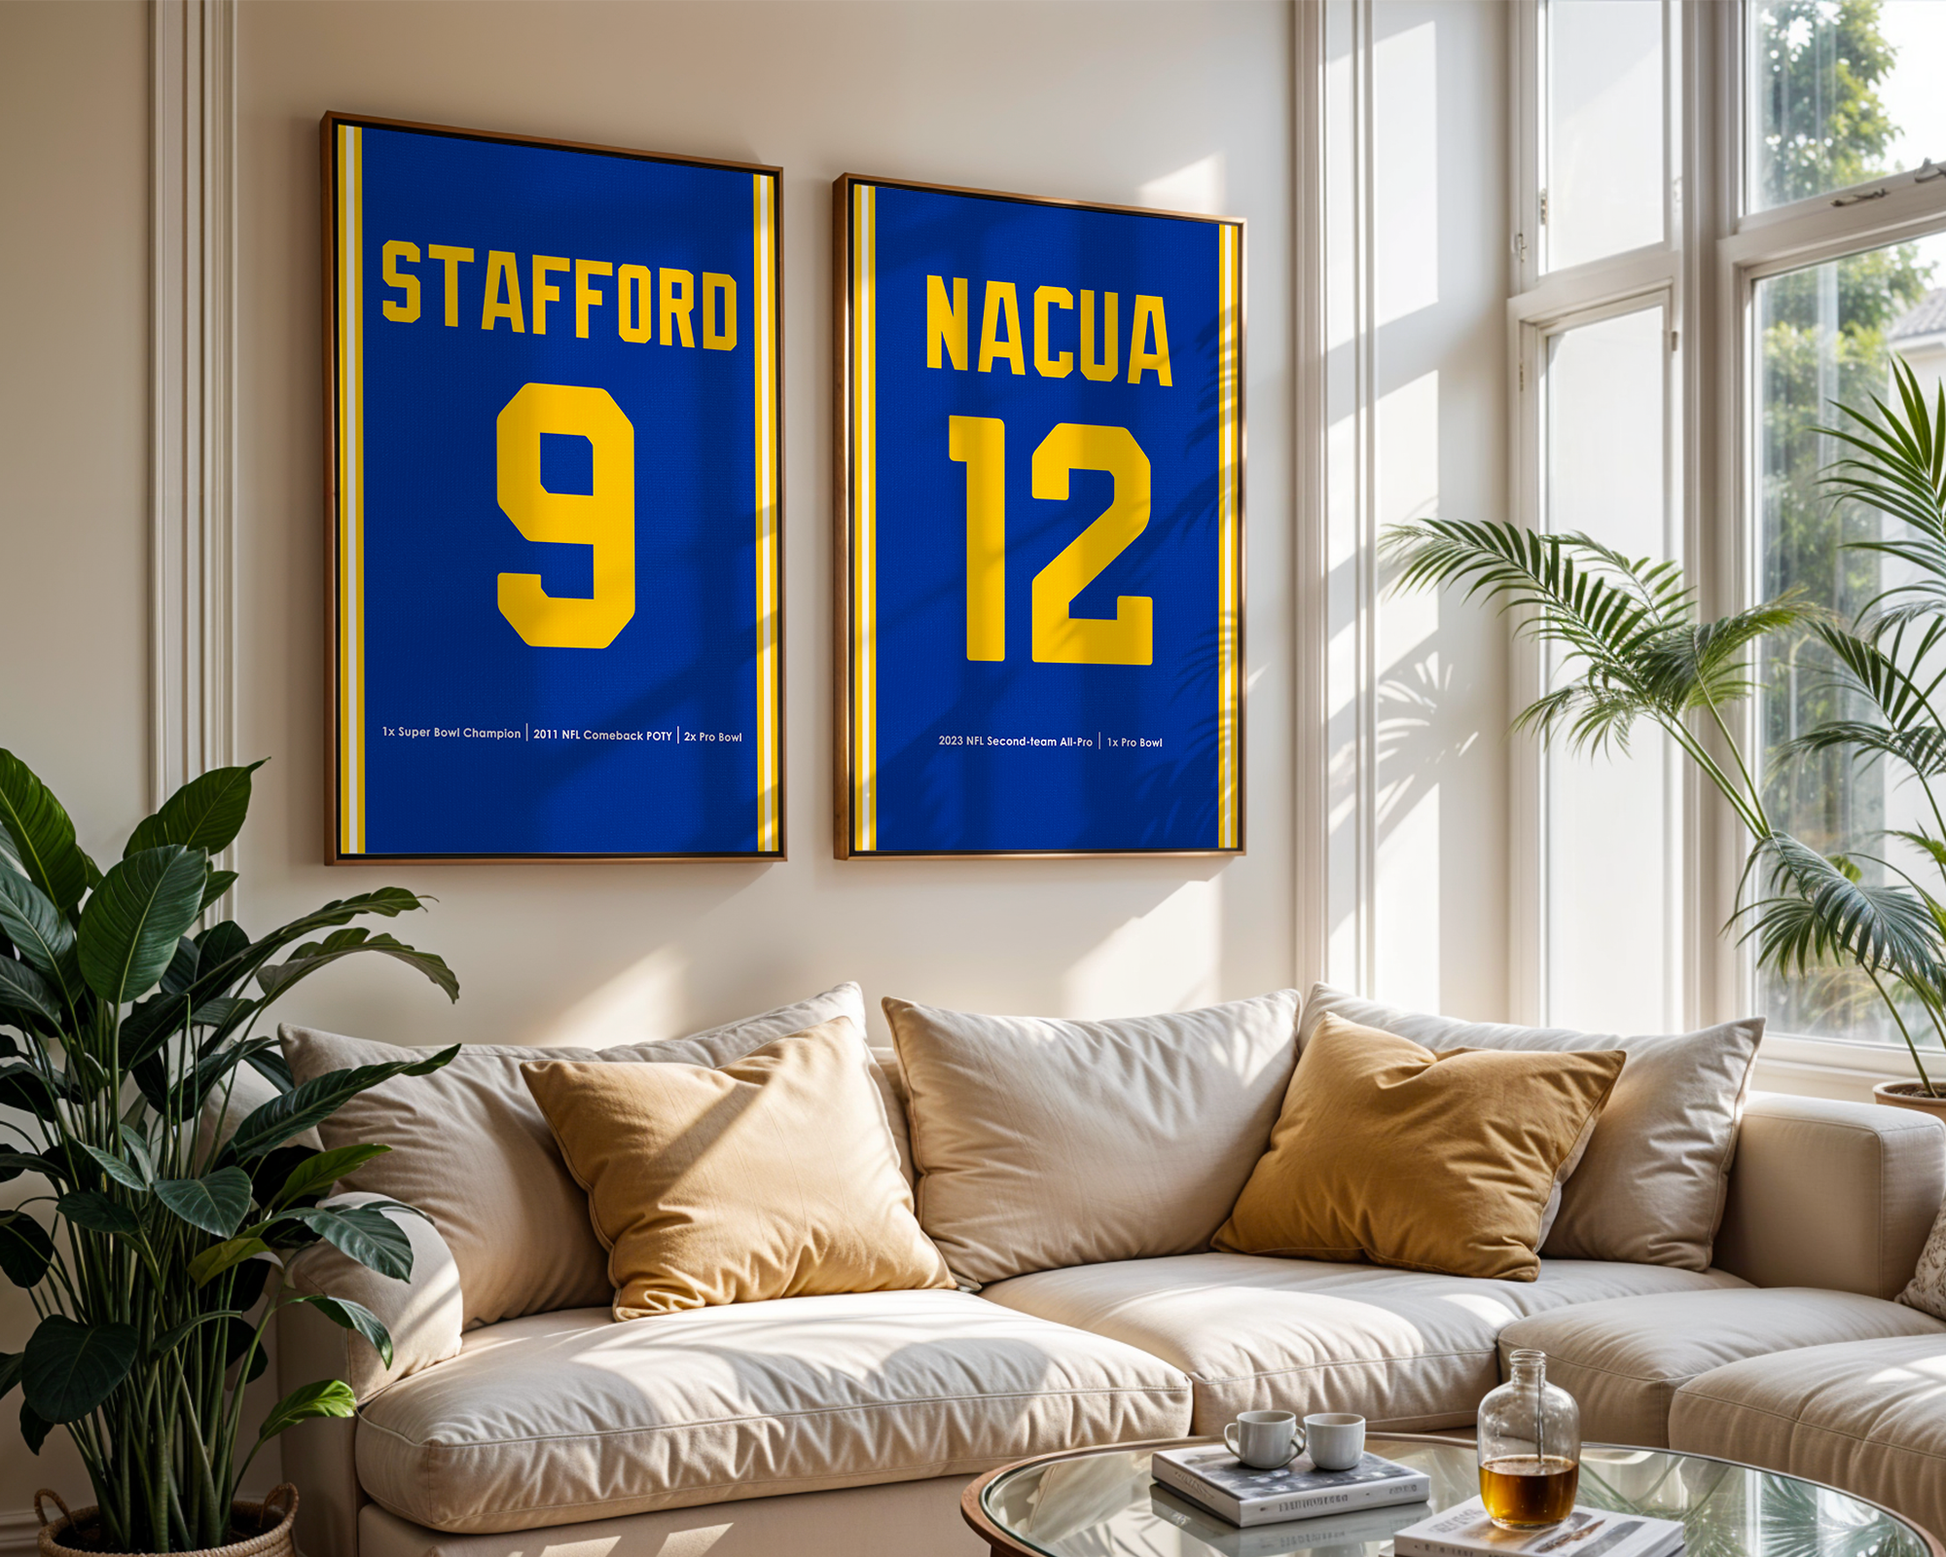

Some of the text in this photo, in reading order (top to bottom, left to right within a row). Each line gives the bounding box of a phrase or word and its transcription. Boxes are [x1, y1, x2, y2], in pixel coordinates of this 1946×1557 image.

[382, 239, 738, 352] STAFFORD
[926, 274, 1173, 387] NACUA
[496, 382, 636, 650] 9
[948, 414, 1154, 666] 12
[382, 726, 742, 743] 1x Super Bowl Champion 2011 NFL Comeback POTY 2x Pro Bowl
[938, 735, 1163, 748] 2023 NFL Second-team All-Pro 1x Pro Bowl
